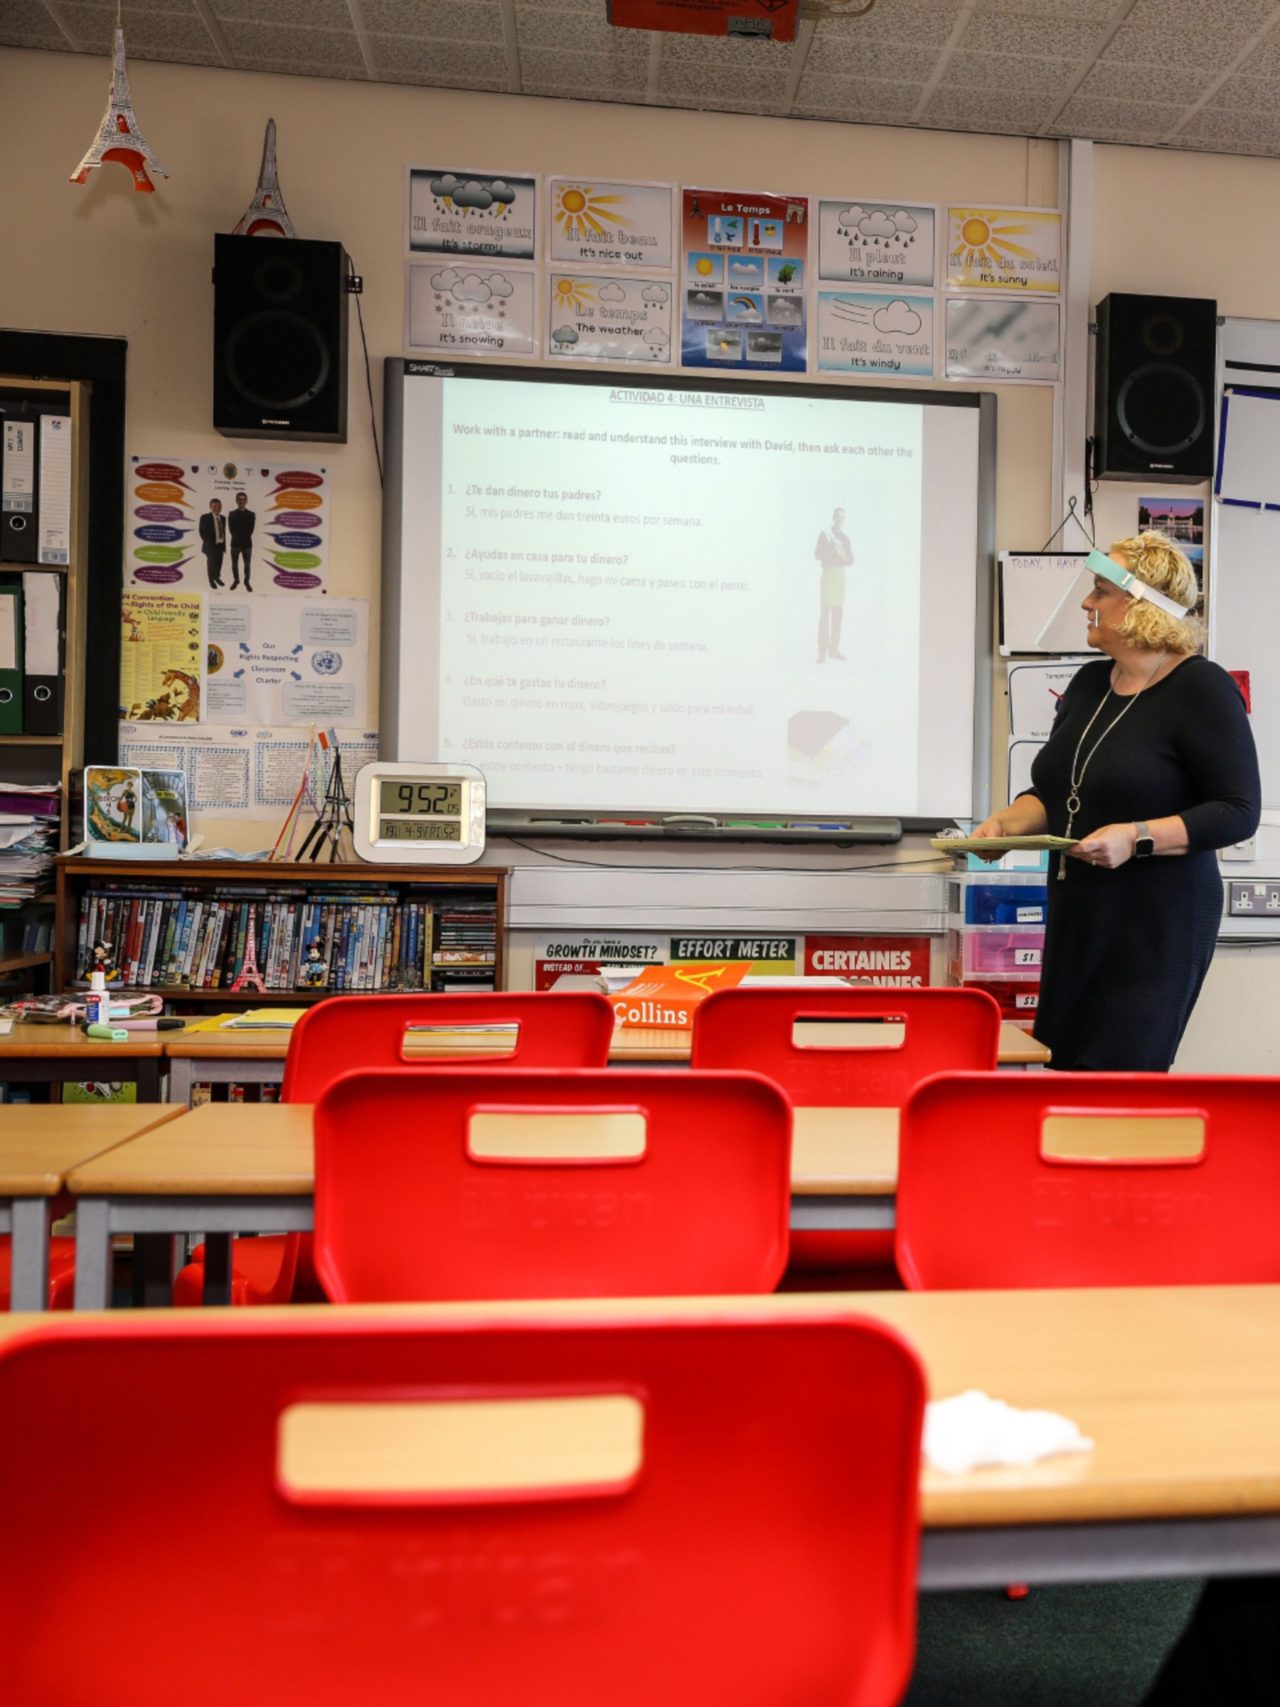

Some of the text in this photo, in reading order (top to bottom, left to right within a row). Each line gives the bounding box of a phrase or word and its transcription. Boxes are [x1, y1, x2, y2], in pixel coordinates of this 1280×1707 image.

[721, 203, 771, 216] Le Temps
[413, 215, 532, 241] Il fait orageux
[584, 229, 615, 245] fait
[618, 230, 658, 247] beau
[580, 247, 644, 261] It's nice out
[866, 247, 907, 267] pleut
[997, 255, 1015, 270] du
[850, 267, 905, 282] It's raining
[980, 273, 1028, 287] It's sunny
[576, 304, 648, 325] Le temps
[576, 323, 644, 337] The weather
[439, 333, 505, 349] It's snowing
[840, 337, 867, 353] fait
[872, 338, 894, 354] du
[896, 341, 931, 356] vent
[851, 357, 901, 371] It's windy
[608, 389, 665, 405] ACTIVIDAD
[679, 393, 703, 407] UNA
[704, 395, 766, 410] ENTREVISTA
[452, 422, 913, 458] Work with a partner: read and understand this interview with David, then ask each other the
[669, 453, 722, 468] questions.
[546, 943, 658, 960] GROWTH MINDSET?
[678, 940, 789, 958] EFFORT METER
[543, 963, 573, 973] INSTEAD
[812, 950, 912, 971] CERTAINES
[613, 1002, 688, 1026] Collins
